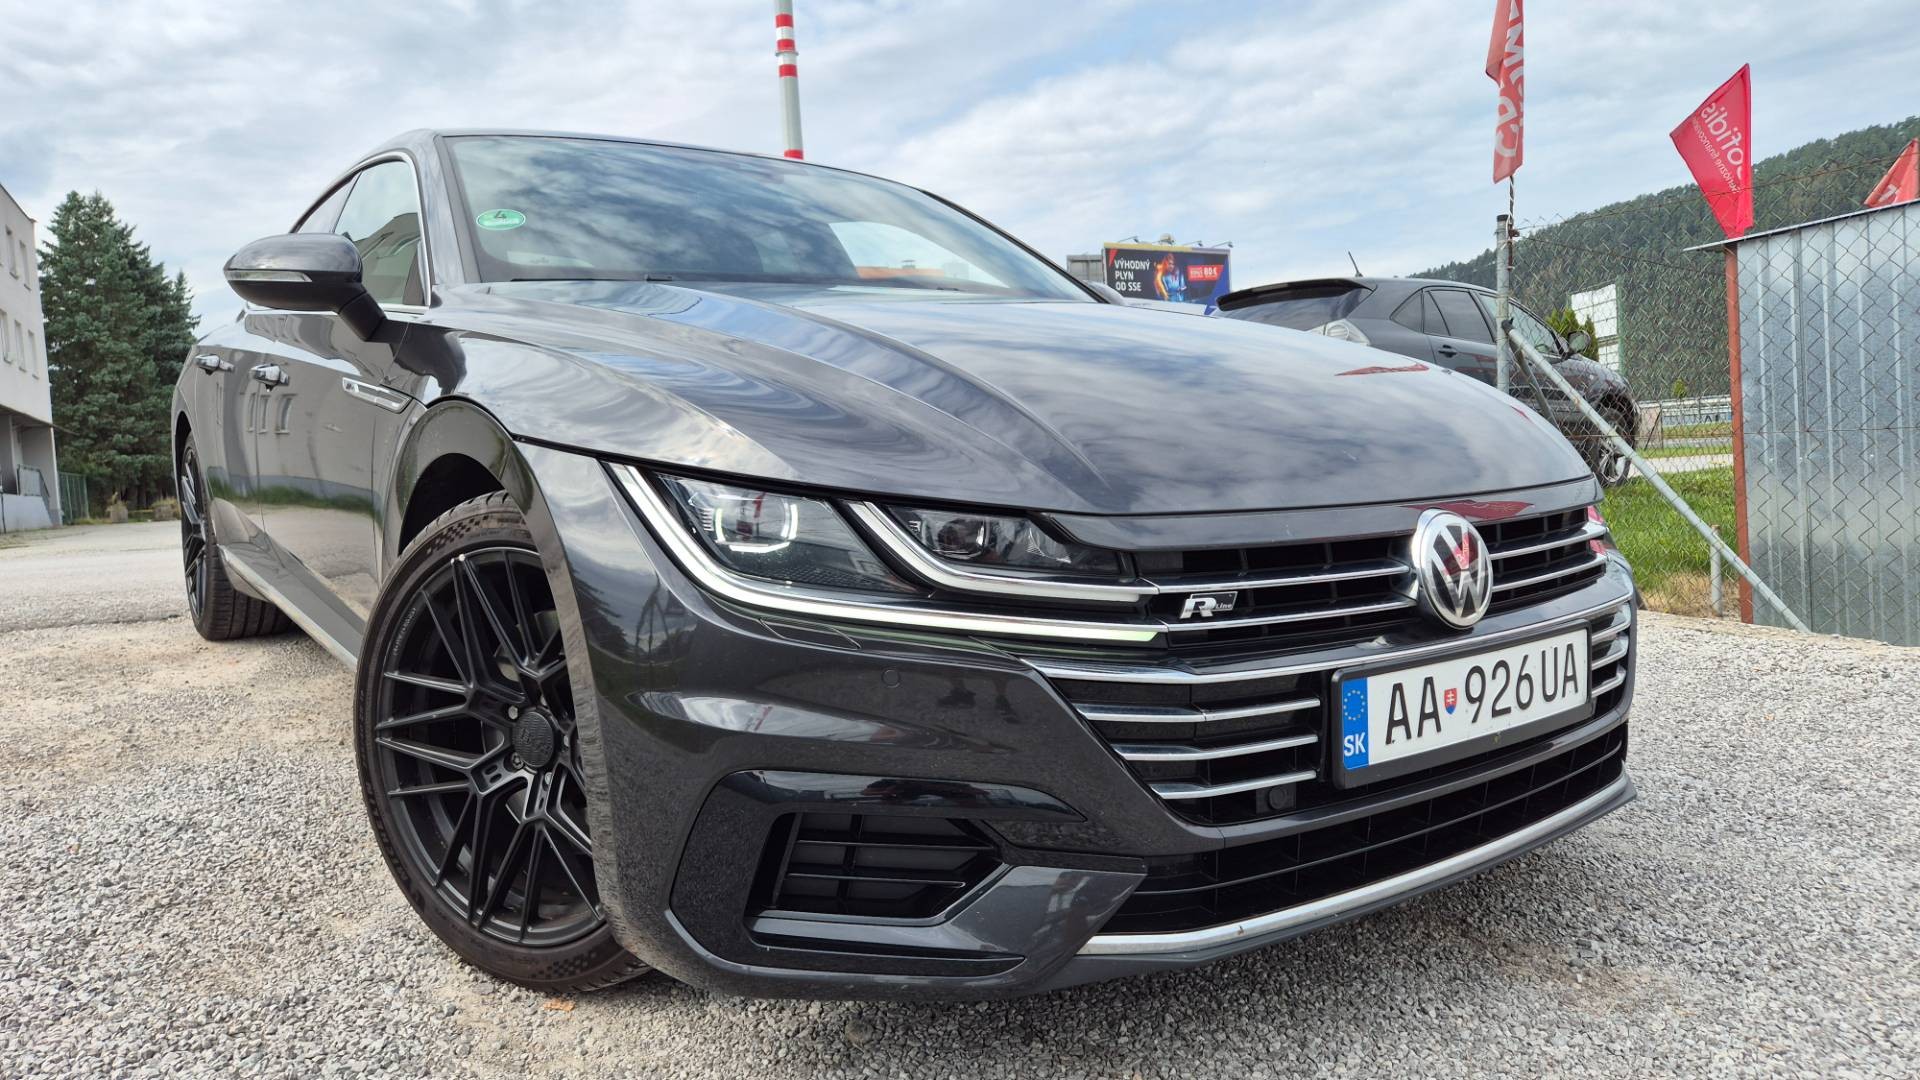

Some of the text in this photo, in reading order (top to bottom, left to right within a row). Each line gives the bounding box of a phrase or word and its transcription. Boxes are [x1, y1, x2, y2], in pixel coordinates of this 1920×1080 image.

[1114, 257, 1151, 270] VÝHODNÝ
[1115, 270, 1134, 280] PLYN
[1115, 281, 1142, 292] OD SSE
[1385, 675, 1442, 745] AA
[1343, 732, 1367, 757] SK
